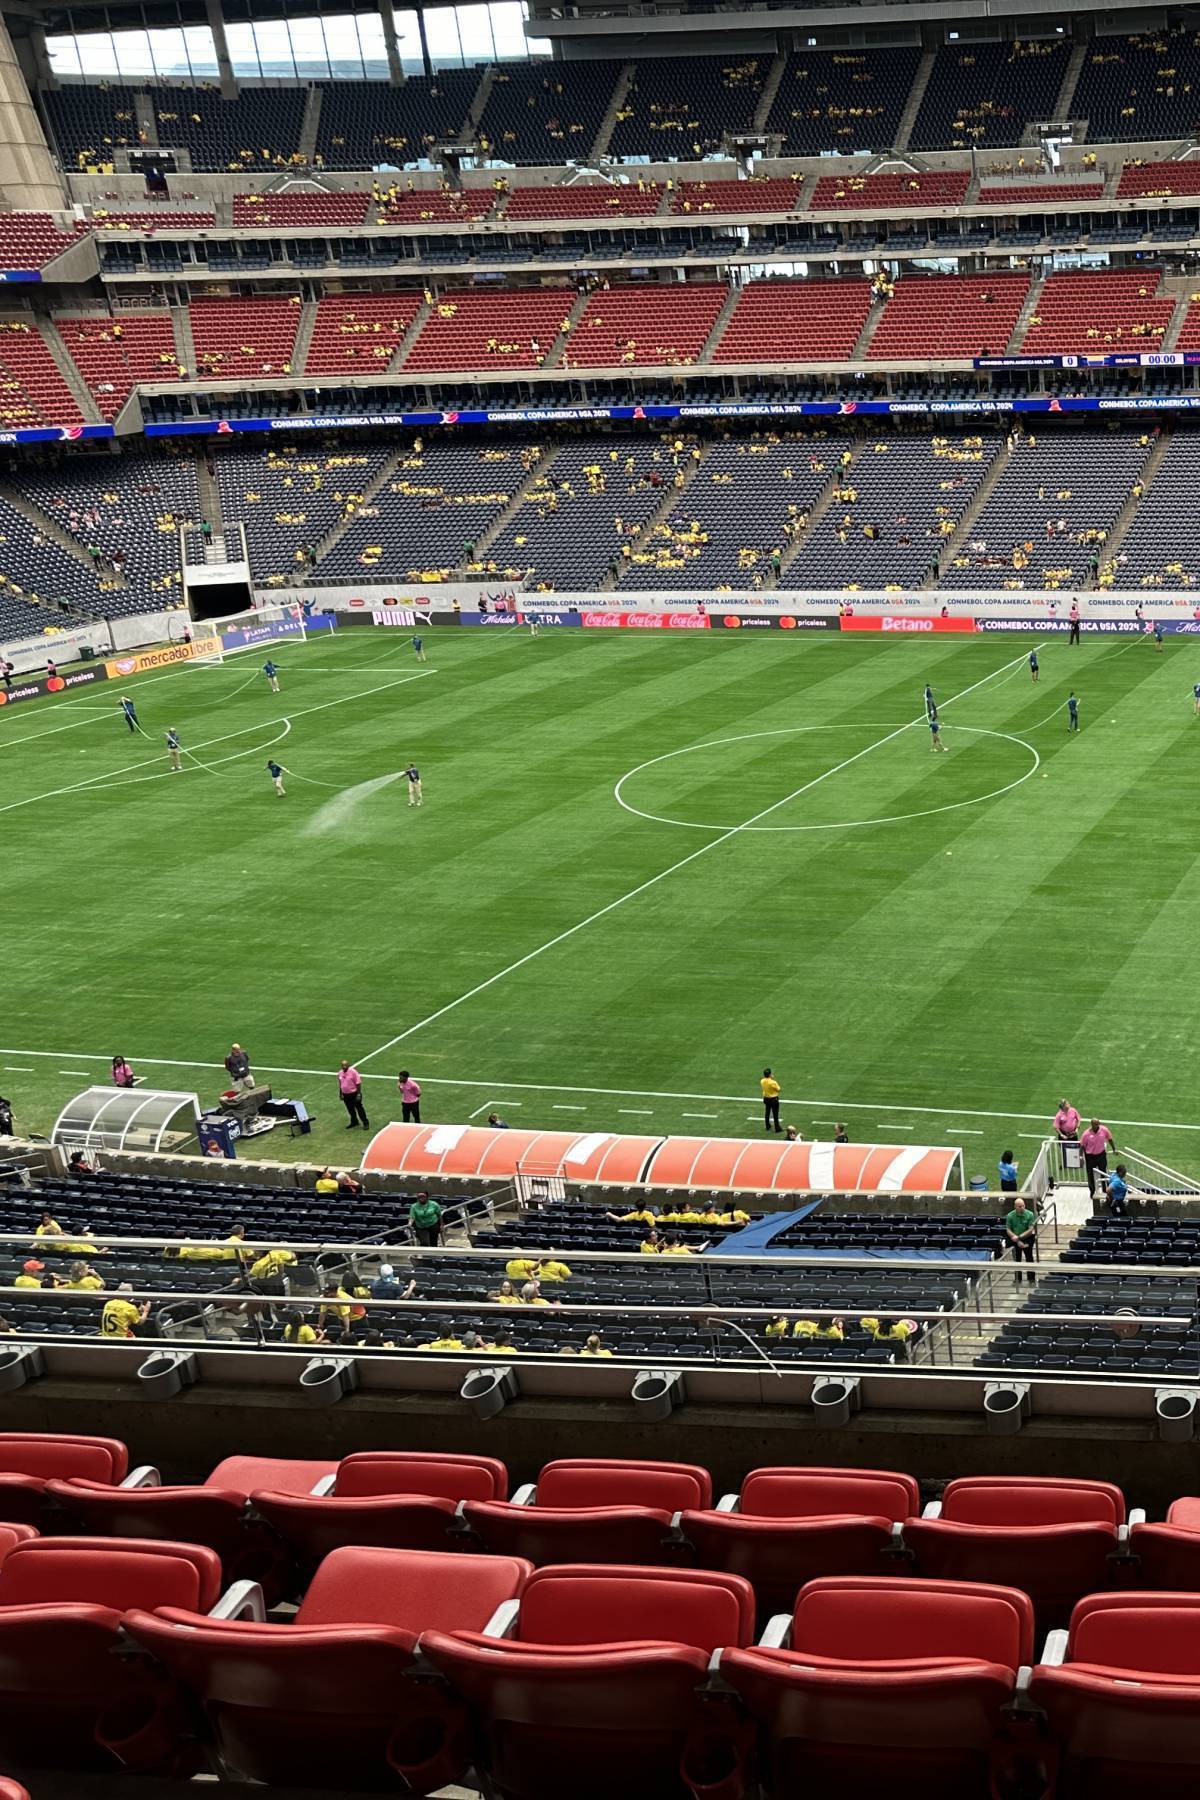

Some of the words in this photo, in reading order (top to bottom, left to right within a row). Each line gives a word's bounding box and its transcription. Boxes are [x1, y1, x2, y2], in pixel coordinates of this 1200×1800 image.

[1138, 400, 1157, 408] COPA
[315, 419, 337, 427] COPA
[337, 417, 369, 425] AMERICA
[372, 612, 415, 625] PUMA
[480, 615, 515, 624] Michelob
[742, 618, 770, 627] priceless
[798, 618, 826, 627] priceless
[882, 618, 933, 631] Betano
[986, 622, 1033, 631] CONMEBOL
[1034, 622, 1057, 631] COPA
[1100, 622, 1117, 630] USA
[1119, 622, 1139, 630] 2024
[140, 646, 189, 667] mercado
[191, 640, 214, 656] libre
[66, 671, 94, 686] priceless
[8, 686, 39, 701] priceless
[104, 1313, 118, 1332] 15
